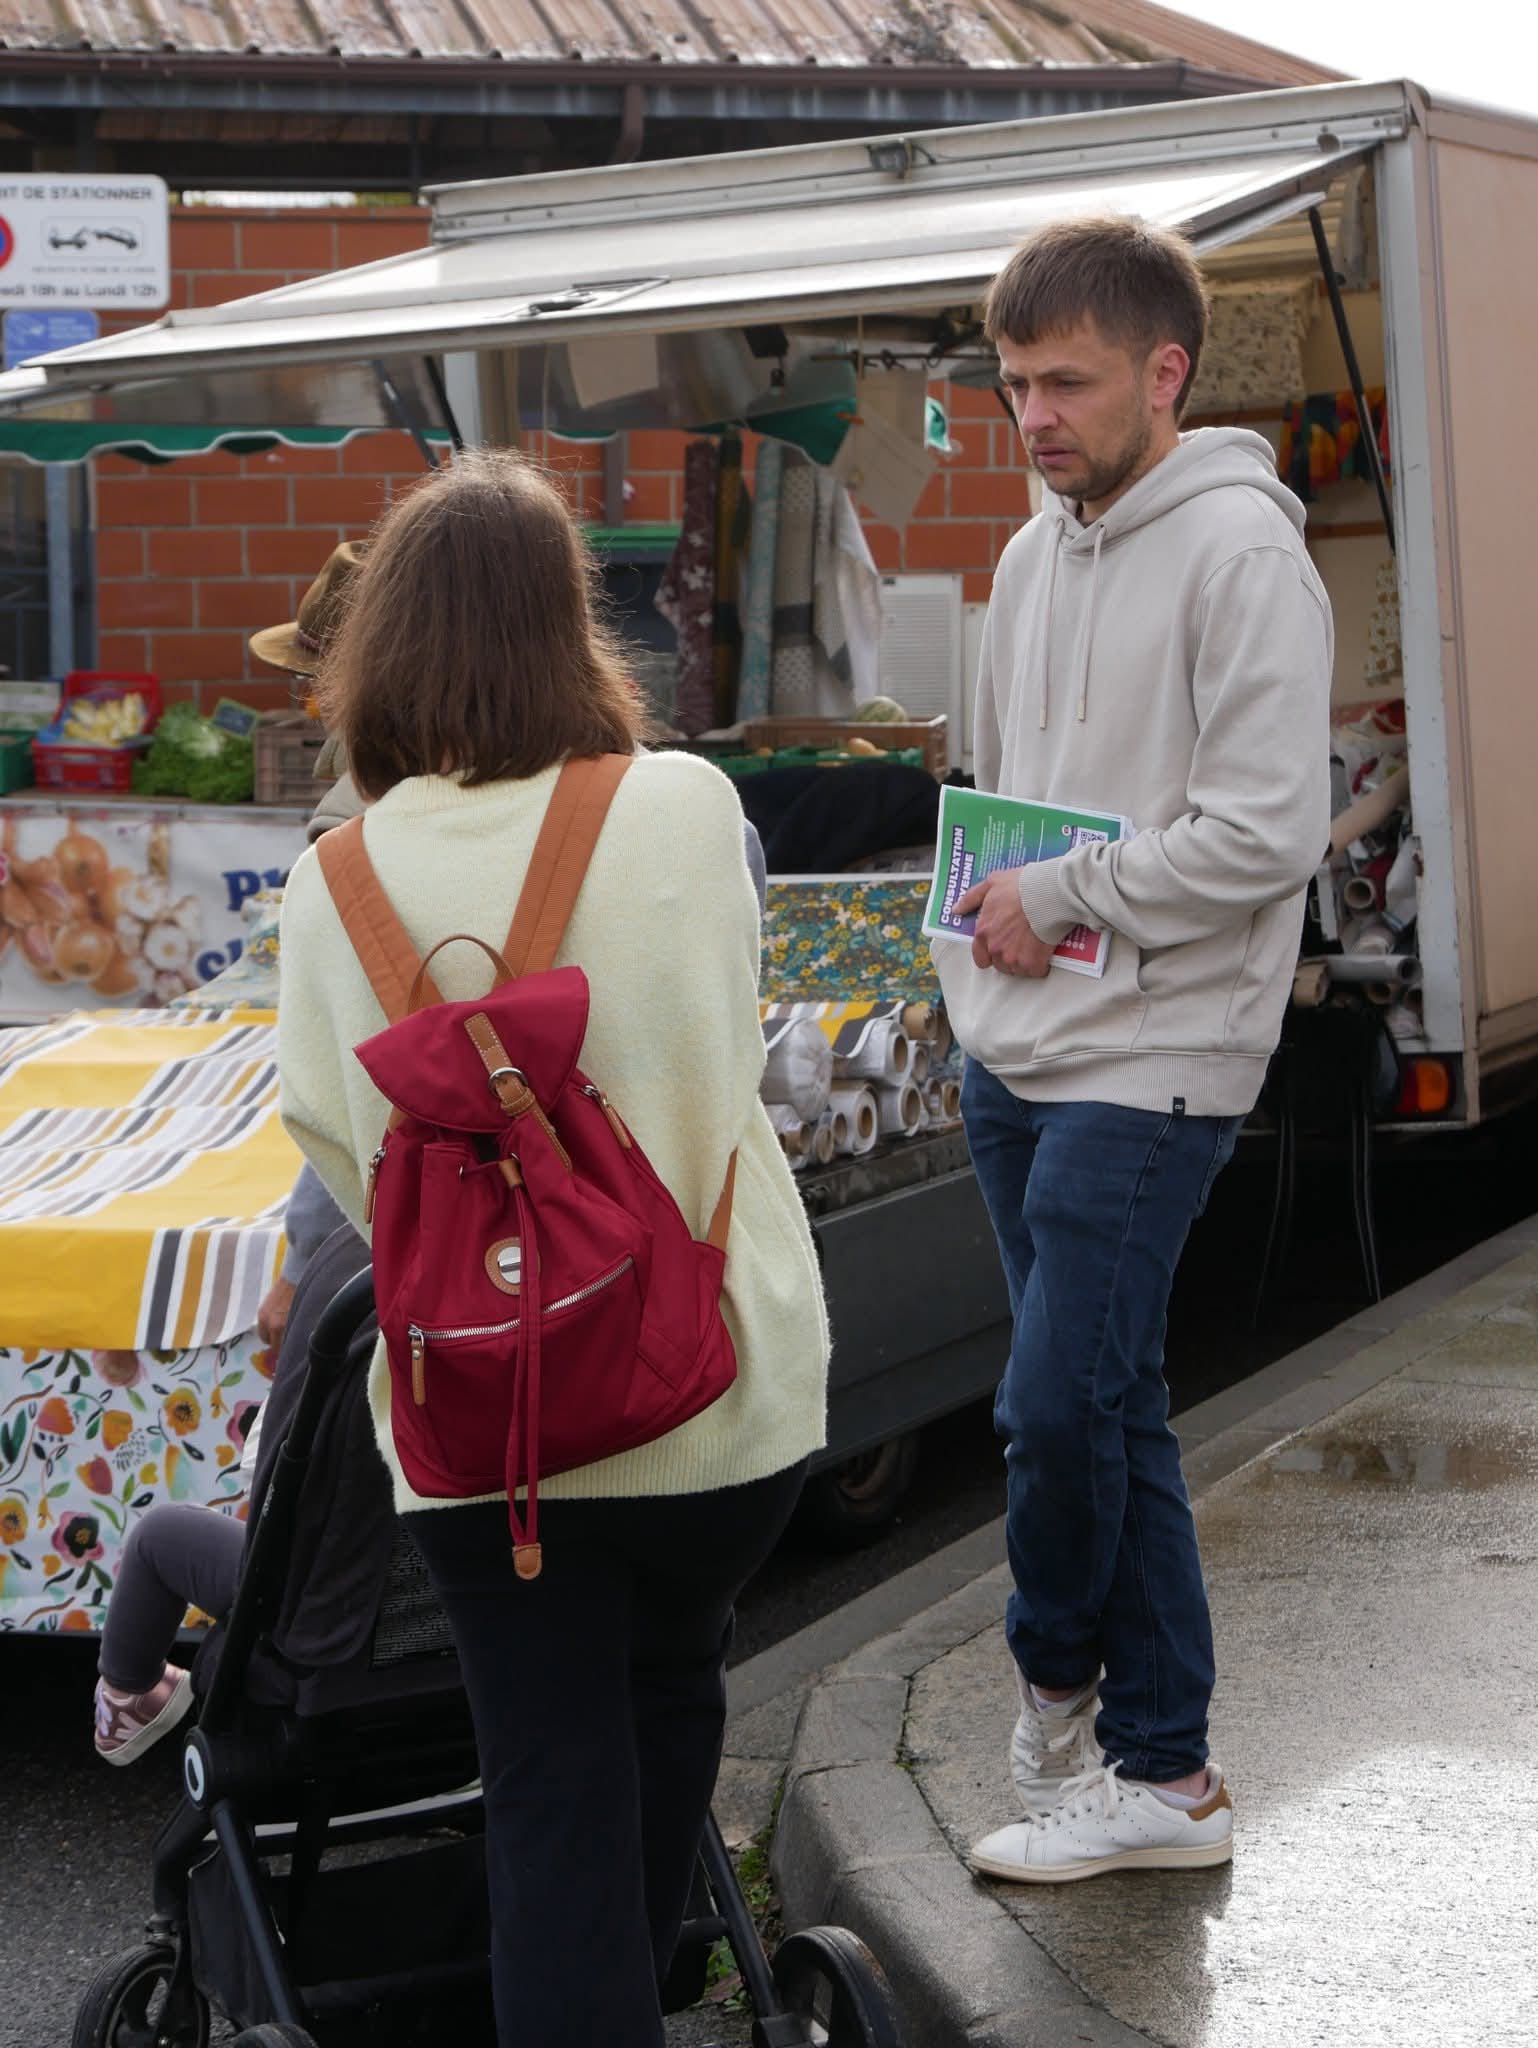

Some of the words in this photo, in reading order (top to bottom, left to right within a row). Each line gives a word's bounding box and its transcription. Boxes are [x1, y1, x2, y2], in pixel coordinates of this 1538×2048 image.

[23, 186, 45, 200] DE
[51, 186, 153, 200] STATIONNER
[63, 286, 80, 297] au
[85, 284, 126, 297] Lundi
[940, 827, 963, 924] CONSULTATION
[952, 853, 974, 927] CYENNE
